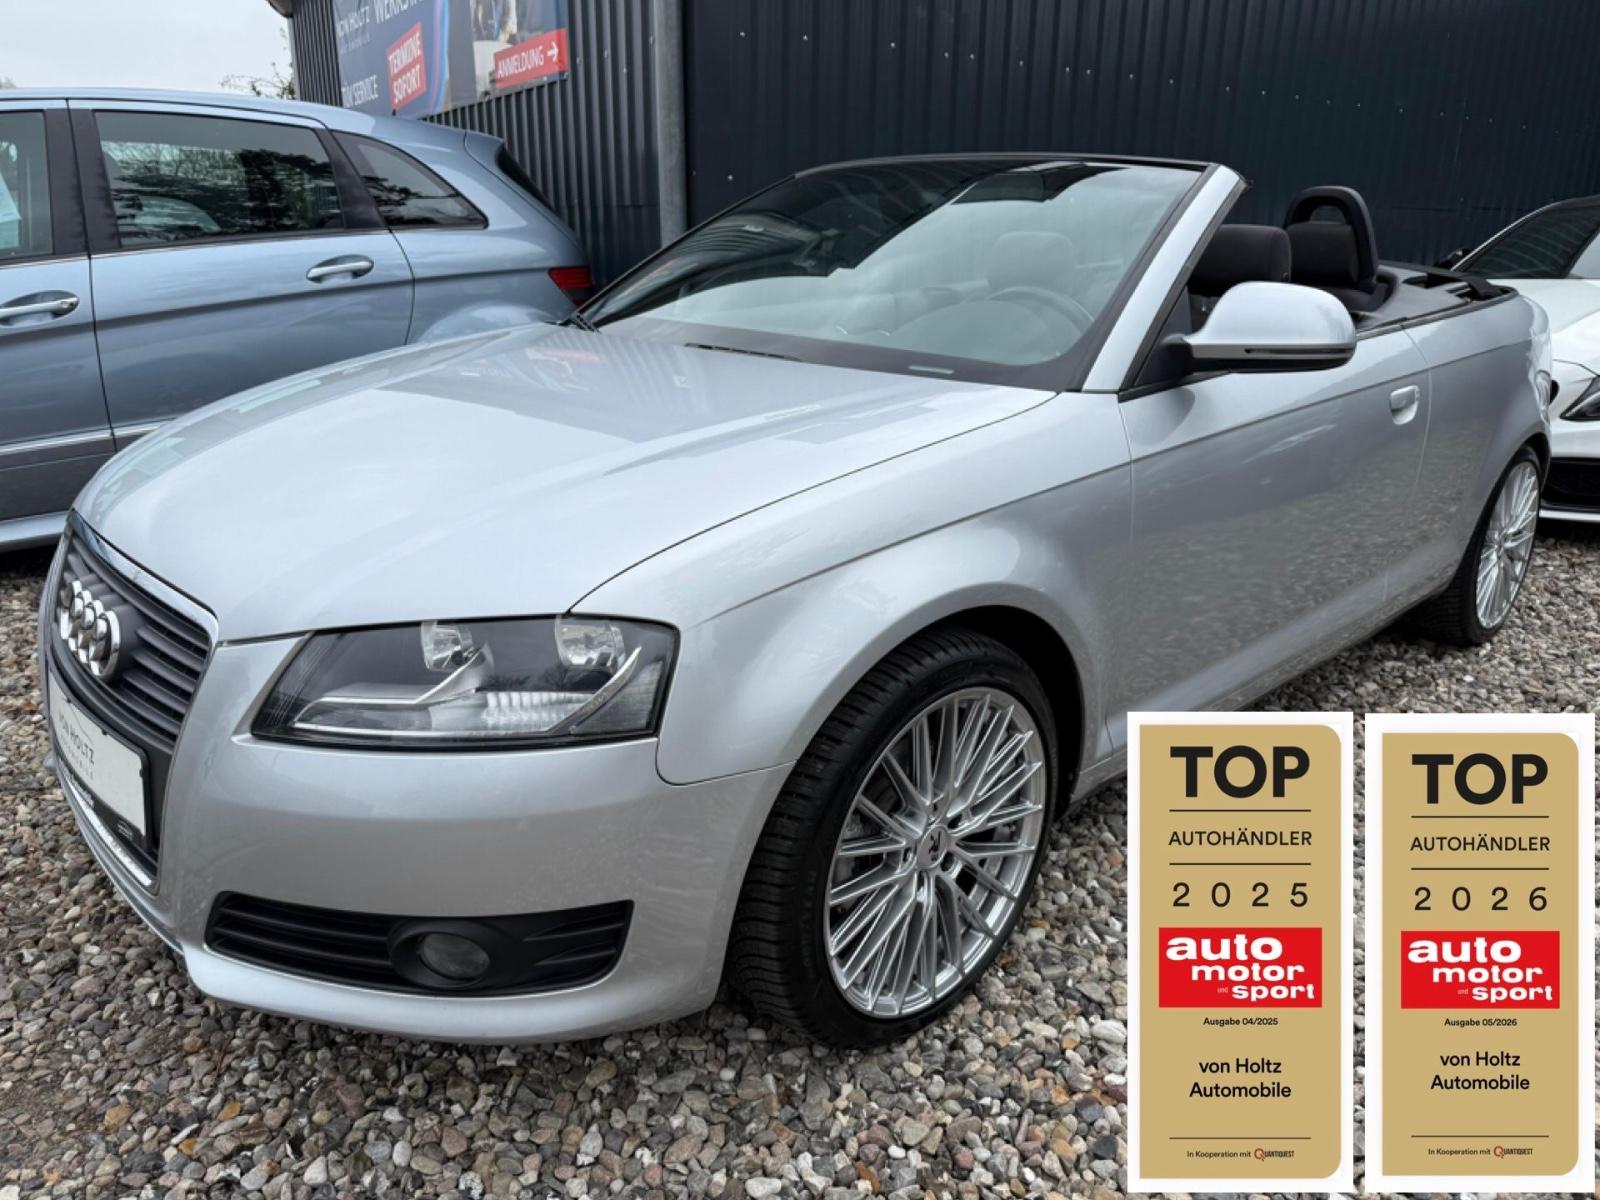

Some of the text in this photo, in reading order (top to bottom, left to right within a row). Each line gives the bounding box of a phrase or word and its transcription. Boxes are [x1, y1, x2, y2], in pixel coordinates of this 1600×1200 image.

[388, 31, 422, 76] TERMINE
[497, 45, 544, 79] ANMELDUNG
[354, 75, 378, 105] SERVICE
[394, 64, 420, 104] SOFORT
[70, 725, 94, 765] HOLTZ
